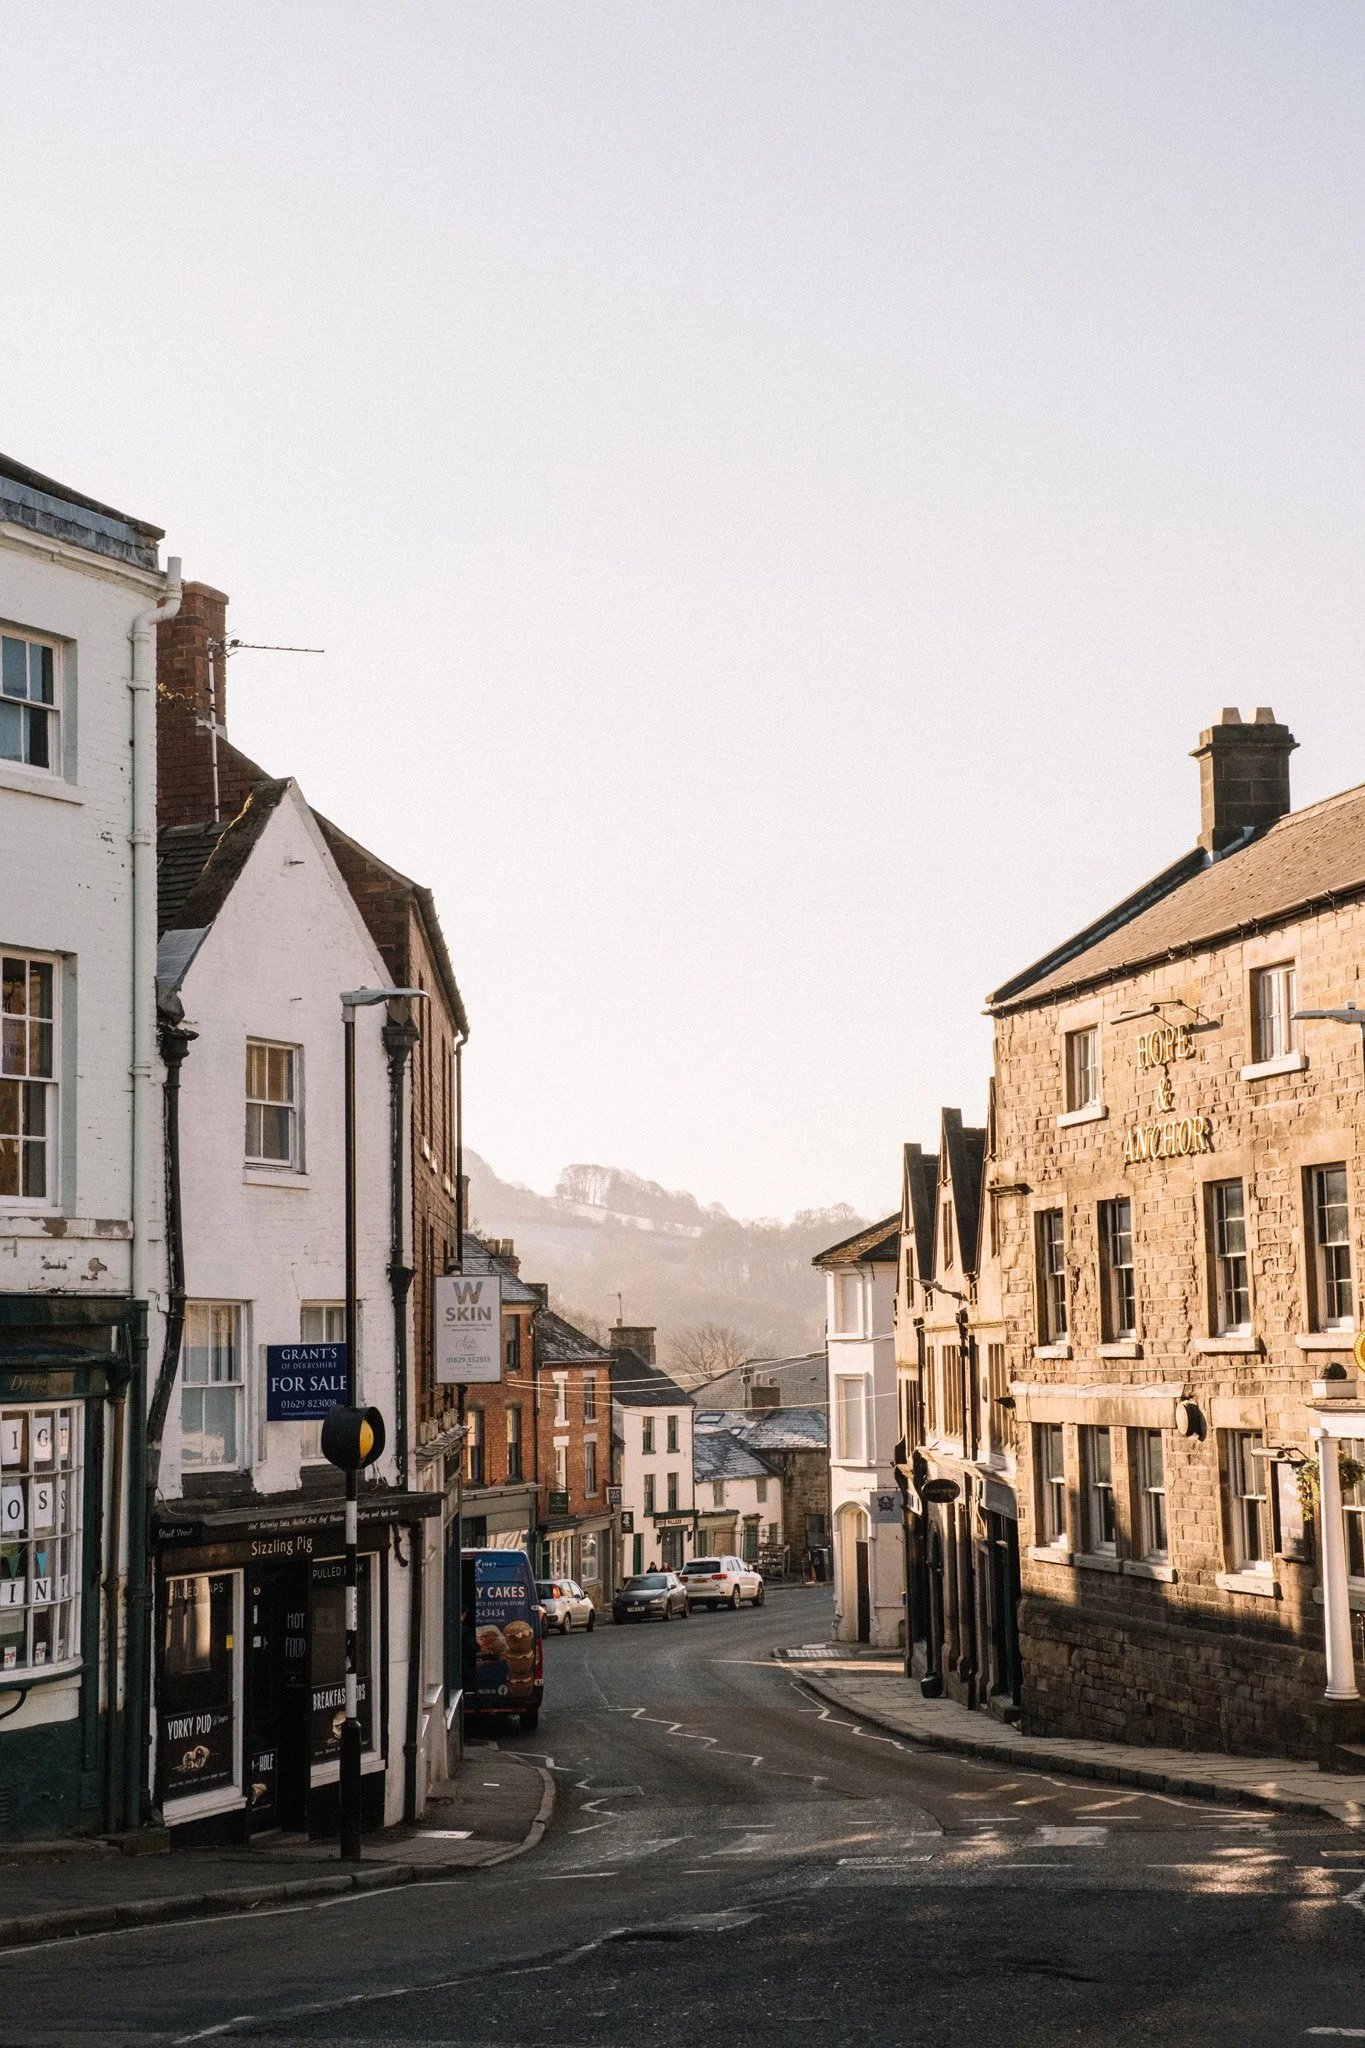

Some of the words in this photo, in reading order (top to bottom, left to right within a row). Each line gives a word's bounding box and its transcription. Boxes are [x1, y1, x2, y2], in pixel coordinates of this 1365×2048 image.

[1136, 1024, 1190, 1068] HOPE
[1156, 1077, 1174, 1112] &
[1124, 1116, 1208, 1163] ANCHOR
[452, 1282, 484, 1304] W
[446, 1306, 492, 1322] SKIN
[282, 1348, 337, 1360] GRANT'S
[272, 1377, 306, 1392] FOR
[310, 1376, 346, 1391] SALE
[281, 1400, 305, 1408] 01629
[252, 1540, 293, 1556] Sizzling
[297, 1536, 313, 1553] Pig
[312, 1566, 341, 1579] PULLED
[488, 1586, 525, 1598] CAKES
[287, 1613, 305, 1630] HOT
[285, 1637, 306, 1658] FOOD
[313, 1688, 346, 1711] BREAKFAS
[168, 1717, 194, 1740] YORKY
[196, 1714, 212, 1734] PUD
[260, 1754, 274, 1772] HOLE
